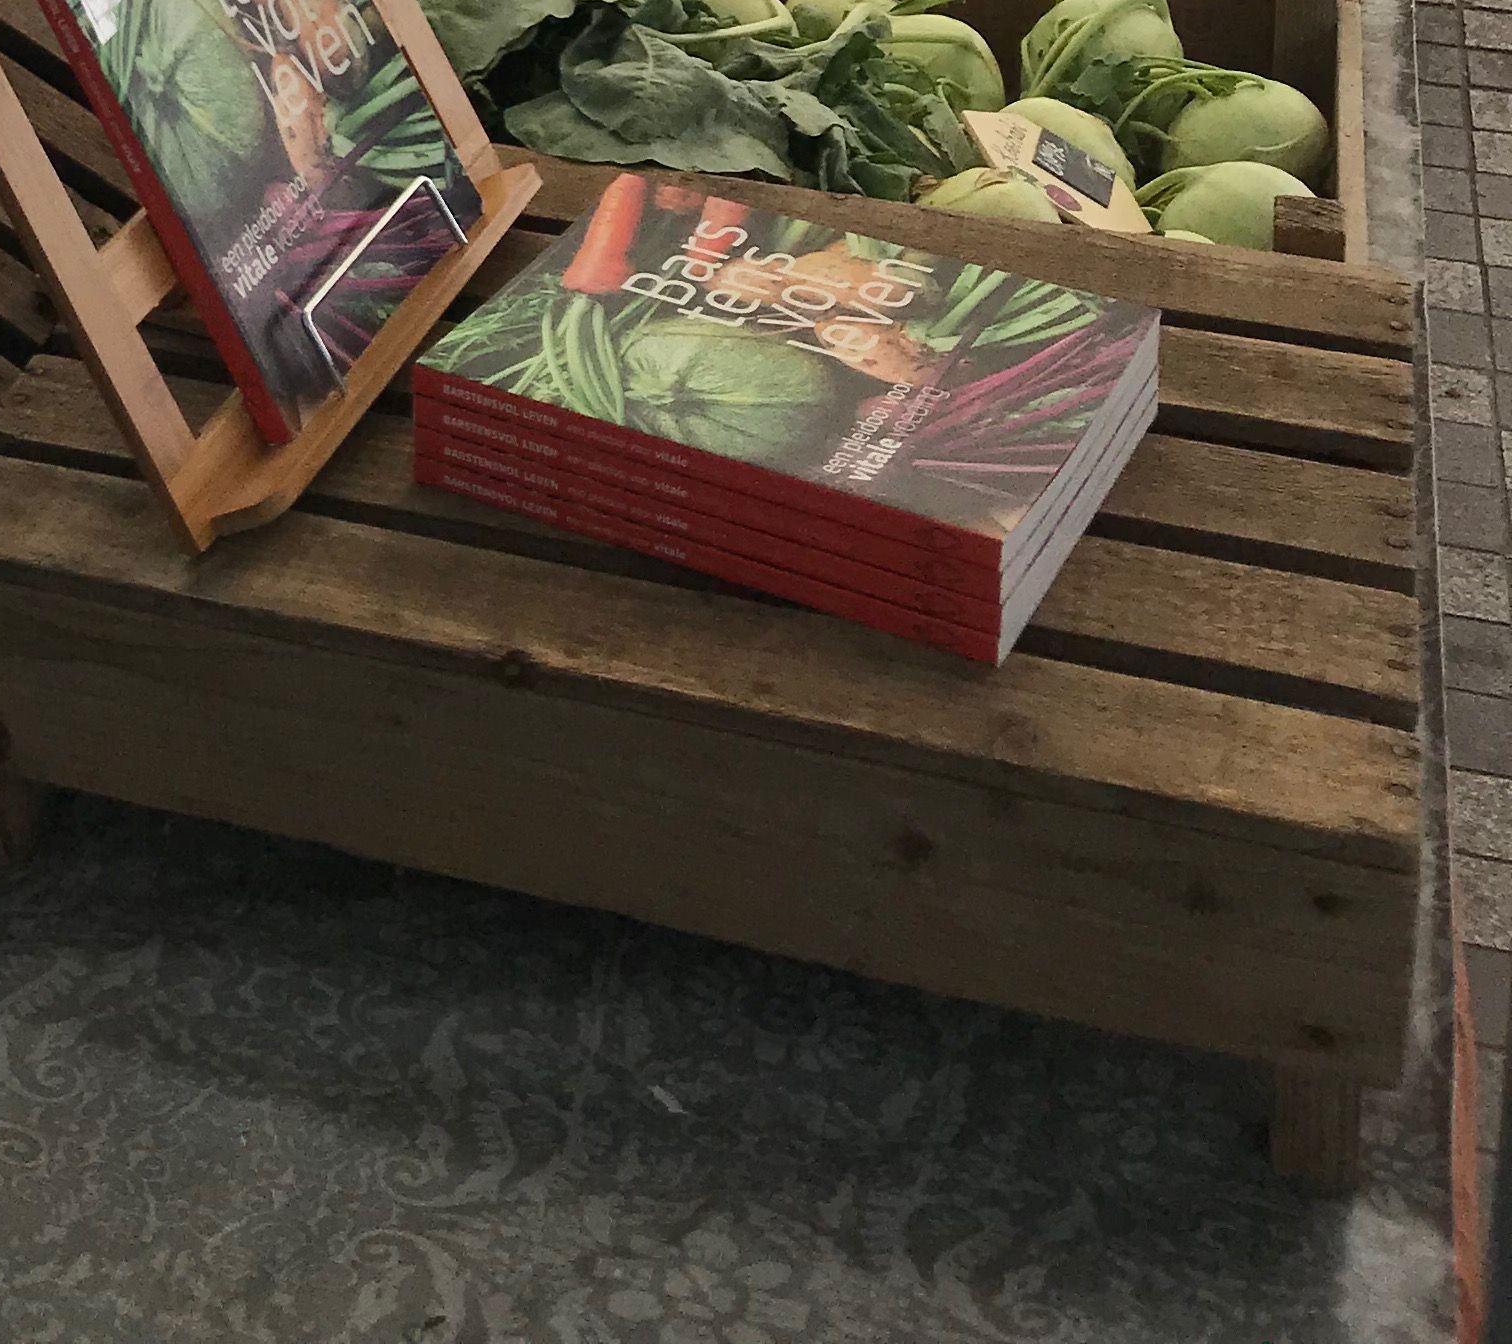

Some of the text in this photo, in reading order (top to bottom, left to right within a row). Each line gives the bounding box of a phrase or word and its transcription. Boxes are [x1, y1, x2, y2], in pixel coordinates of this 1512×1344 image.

[251, 2, 376, 124] leven
[222, 243, 246, 273] een
[233, 244, 279, 299] vitale
[620, 220, 748, 306] Bars
[677, 246, 797, 328] tens
[756, 252, 851, 328] vol
[786, 258, 934, 363] leven
[522, 410, 558, 428] LEVEN
[823, 379, 914, 474] een pleidooi voor
[848, 385, 951, 482] vitale voeding
